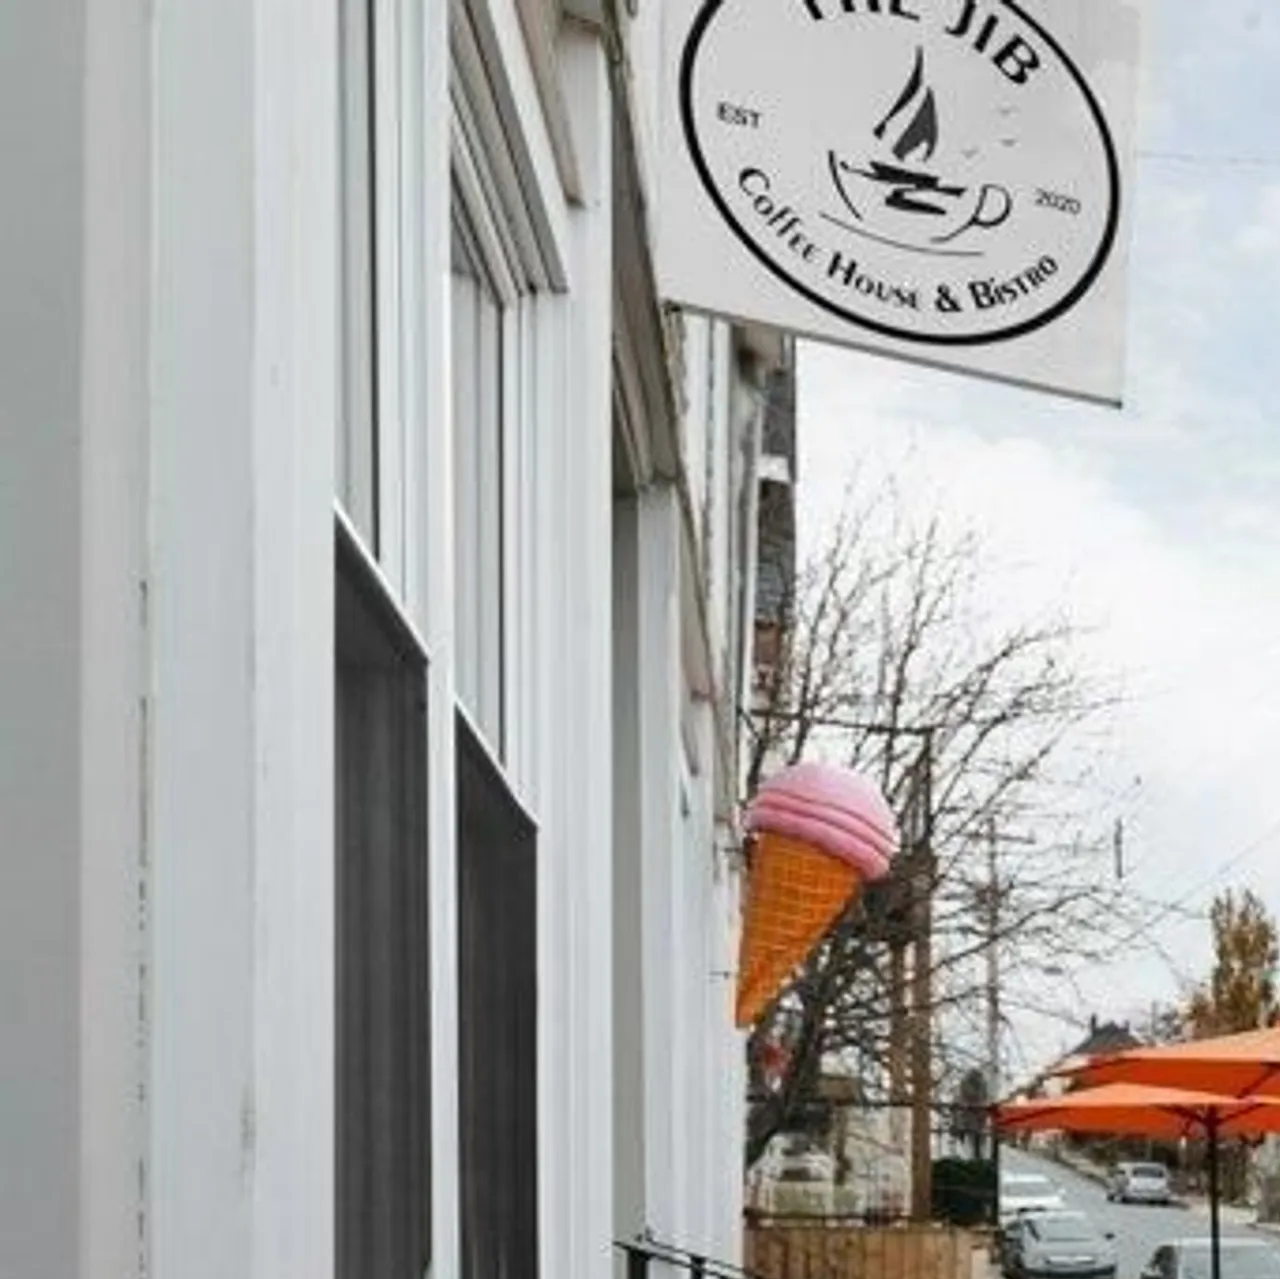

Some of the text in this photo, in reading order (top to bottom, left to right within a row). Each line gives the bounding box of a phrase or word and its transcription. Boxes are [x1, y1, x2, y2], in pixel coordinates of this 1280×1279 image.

[717, 101, 762, 130] EST
[1035, 187, 1083, 216] 2020
[934, 283, 963, 312] &
